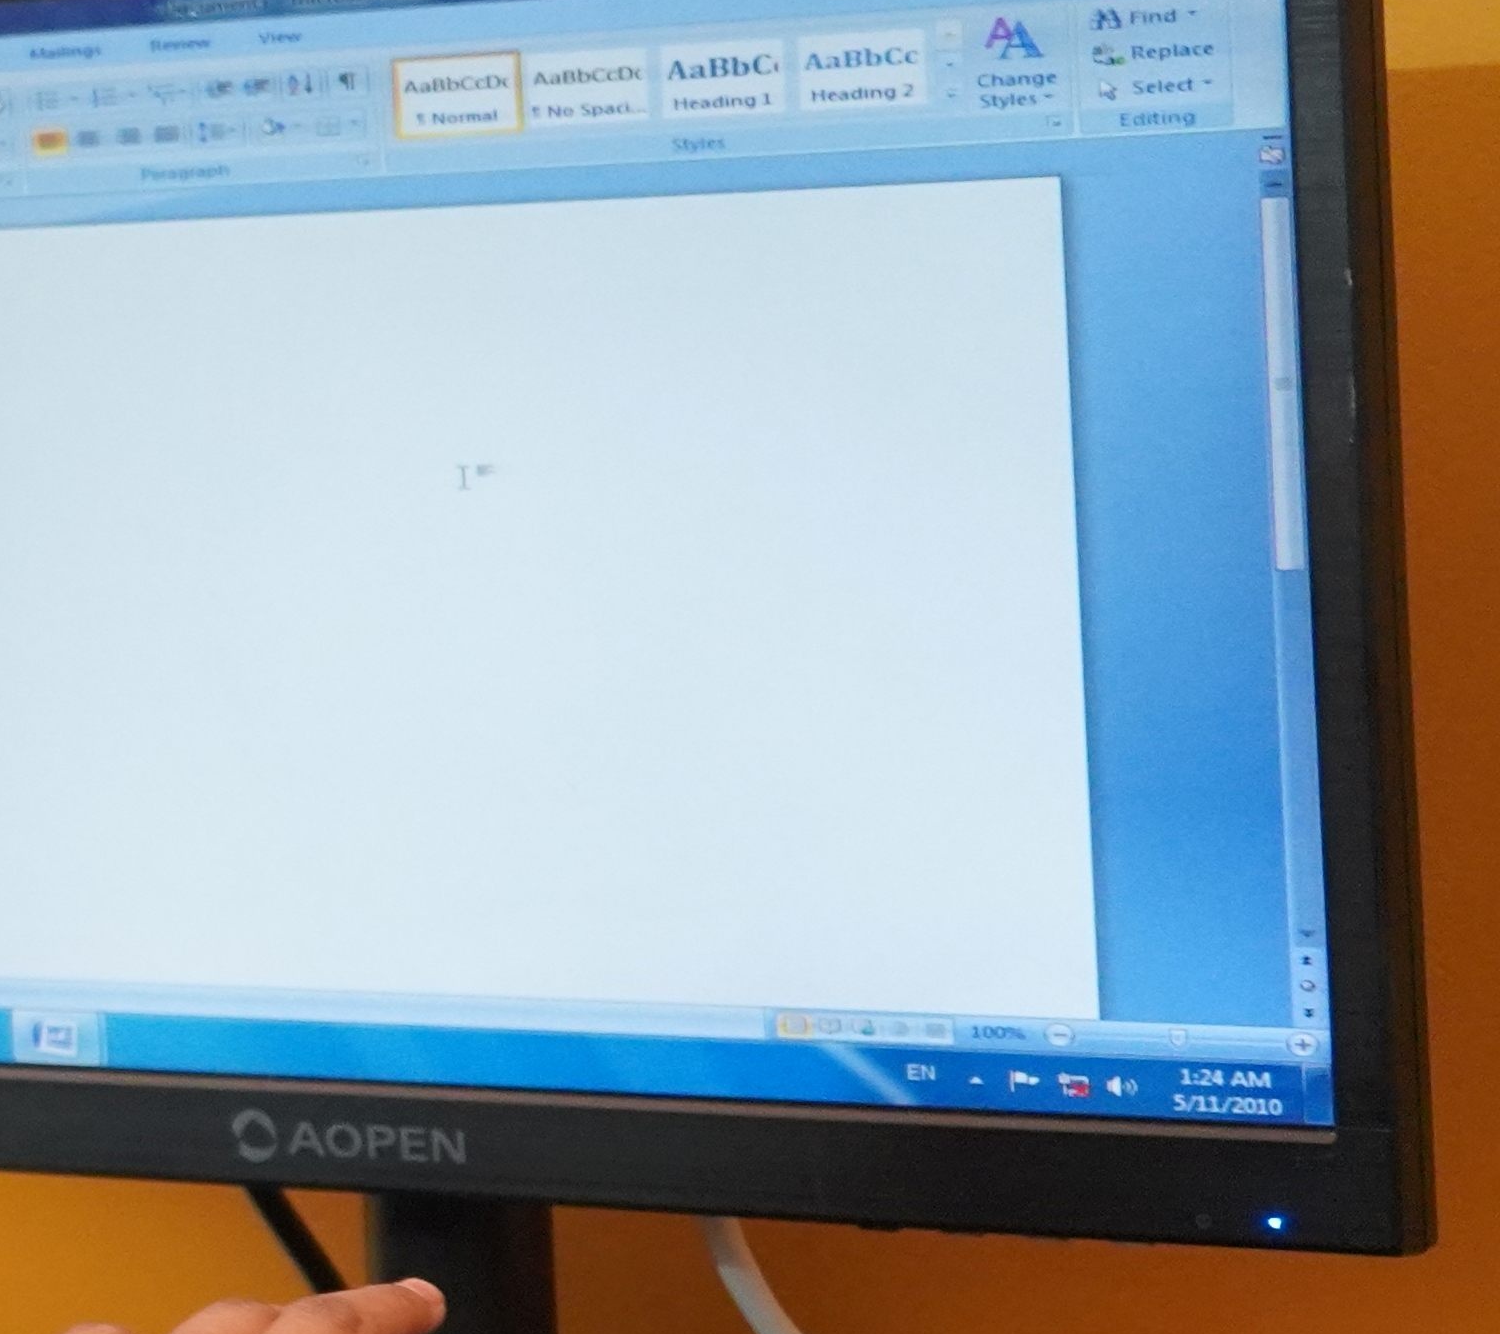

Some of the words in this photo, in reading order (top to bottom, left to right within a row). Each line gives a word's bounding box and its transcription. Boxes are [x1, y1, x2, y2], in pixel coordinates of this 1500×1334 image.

[1129, 9, 1177, 24] Find
[149, 38, 212, 54] Review
[258, 32, 302, 45] View
[29, 45, 102, 60] Mailings
[1130, 42, 1215, 62] Replace
[977, 71, 1058, 91] Change
[1132, 78, 1194, 94] Select
[673, 93, 757, 111] Heading
[762, 92, 773, 107] 1
[811, 85, 897, 103] Heading
[902, 82, 915, 98] 2
[980, 93, 1038, 110] Styles
[432, 109, 499, 126] Normal
[547, 104, 575, 119] No
[1119, 110, 1197, 128] Editing
[671, 136, 726, 154] Styles
[971, 1024, 1026, 1041] 100%
[906, 1063, 937, 1082] EN
[1179, 1067, 1224, 1087] 1:24
[1229, 1069, 1271, 1088] AM
[1173, 1094, 1283, 1117] 5/11/2010
[287, 1121, 468, 1165] AOPEN
